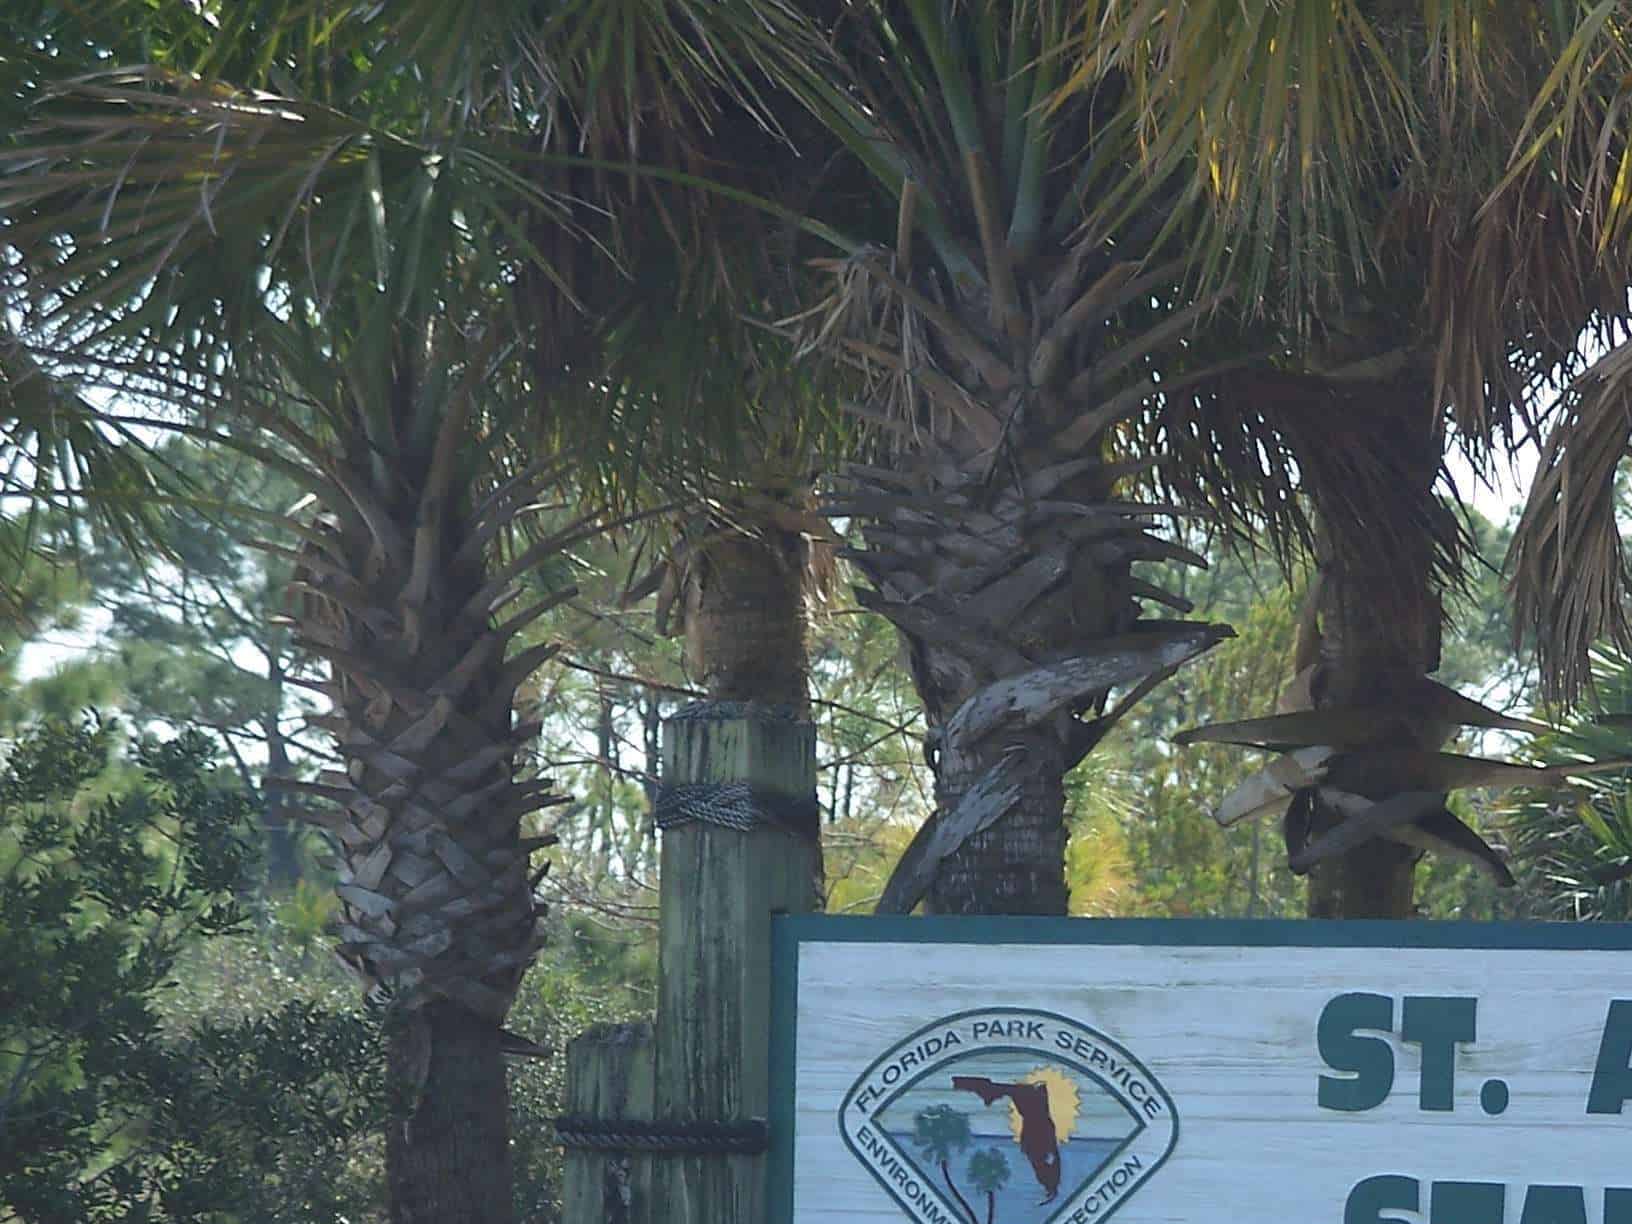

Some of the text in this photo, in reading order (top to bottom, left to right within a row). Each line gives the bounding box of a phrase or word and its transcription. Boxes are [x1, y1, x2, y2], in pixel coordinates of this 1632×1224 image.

[855, 1021, 1162, 1120] FLORIDA PARK SERVICE
[1316, 991, 1509, 1116] ST.
